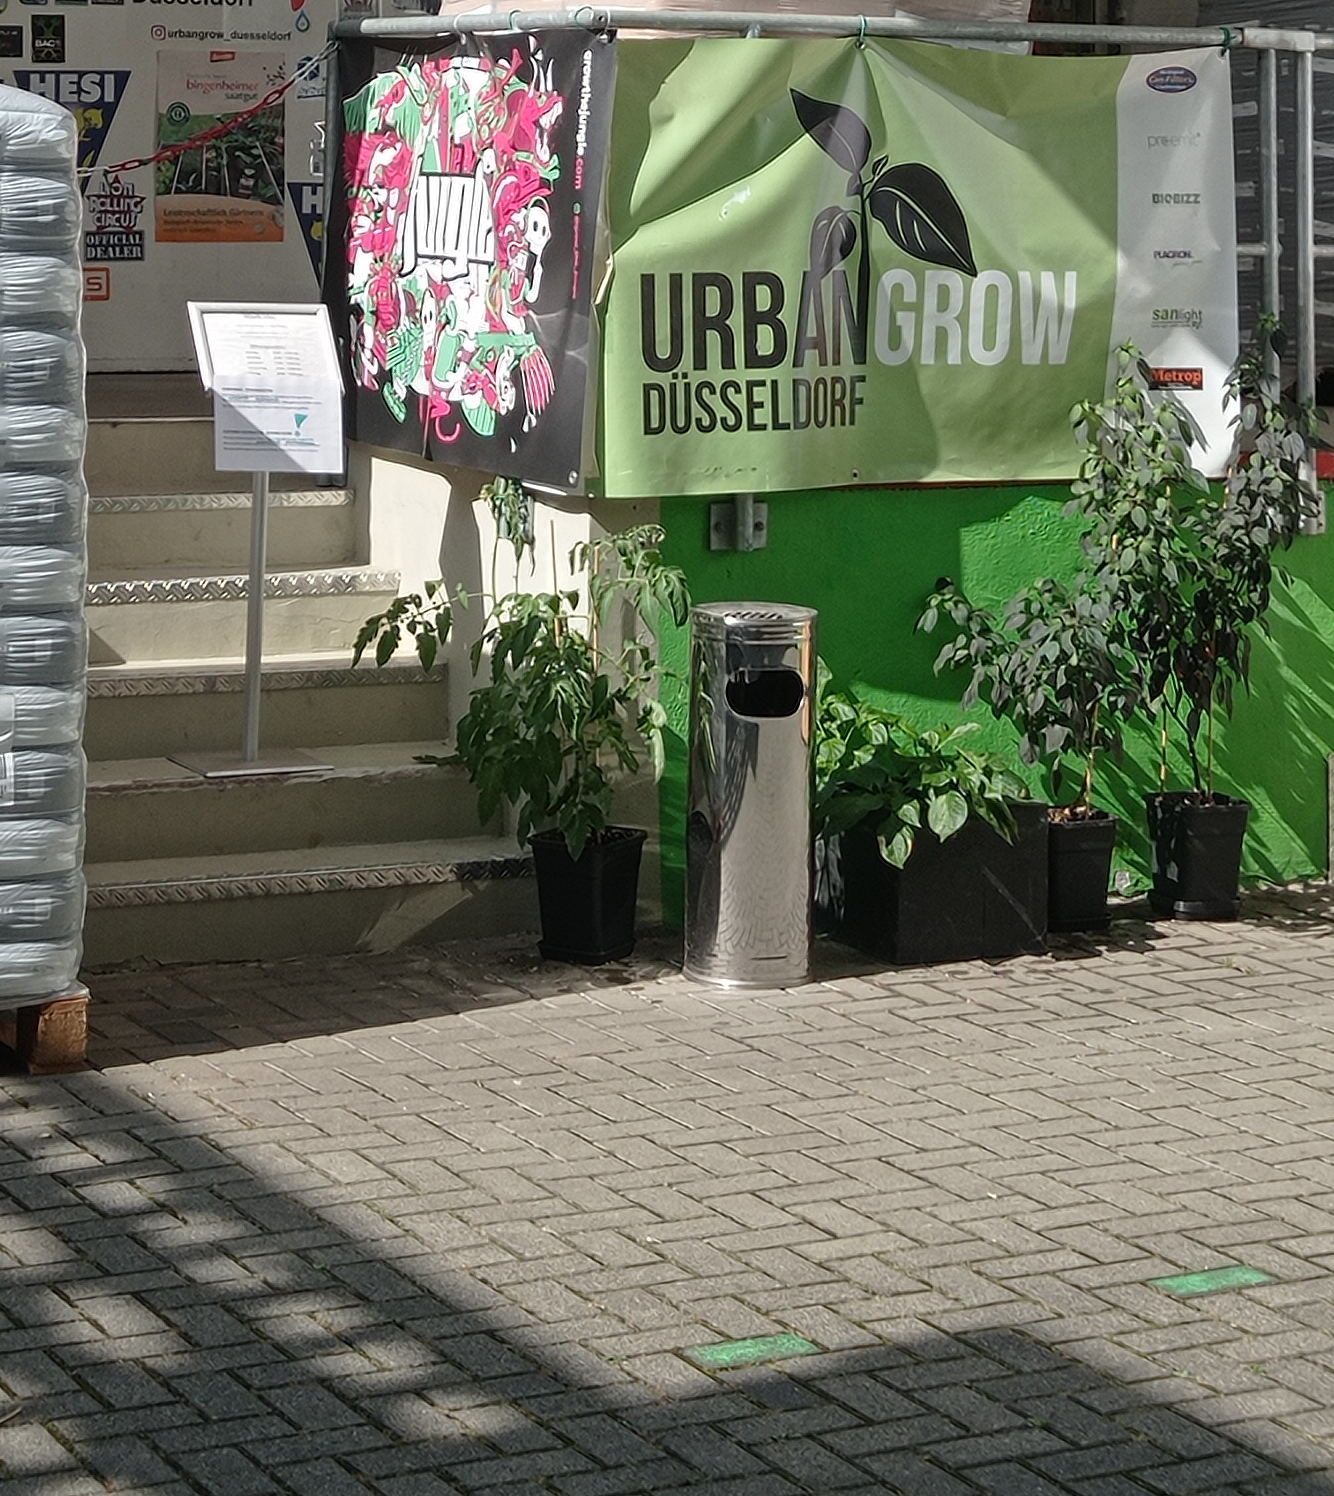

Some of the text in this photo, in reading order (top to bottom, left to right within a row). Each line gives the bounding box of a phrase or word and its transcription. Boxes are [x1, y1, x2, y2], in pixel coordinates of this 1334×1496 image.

[29, 74, 115, 102] HESI
[186, 78, 260, 94] bingenheimer
[88, 195, 143, 214] ROLLING
[94, 211, 139, 228] CIRCUS
[87, 233, 143, 246] OFFICIAL
[86, 245, 143, 259] DEALER
[1153, 250, 1192, 260] PLAGRON
[642, 371, 866, 436] DÜSSELDORF
